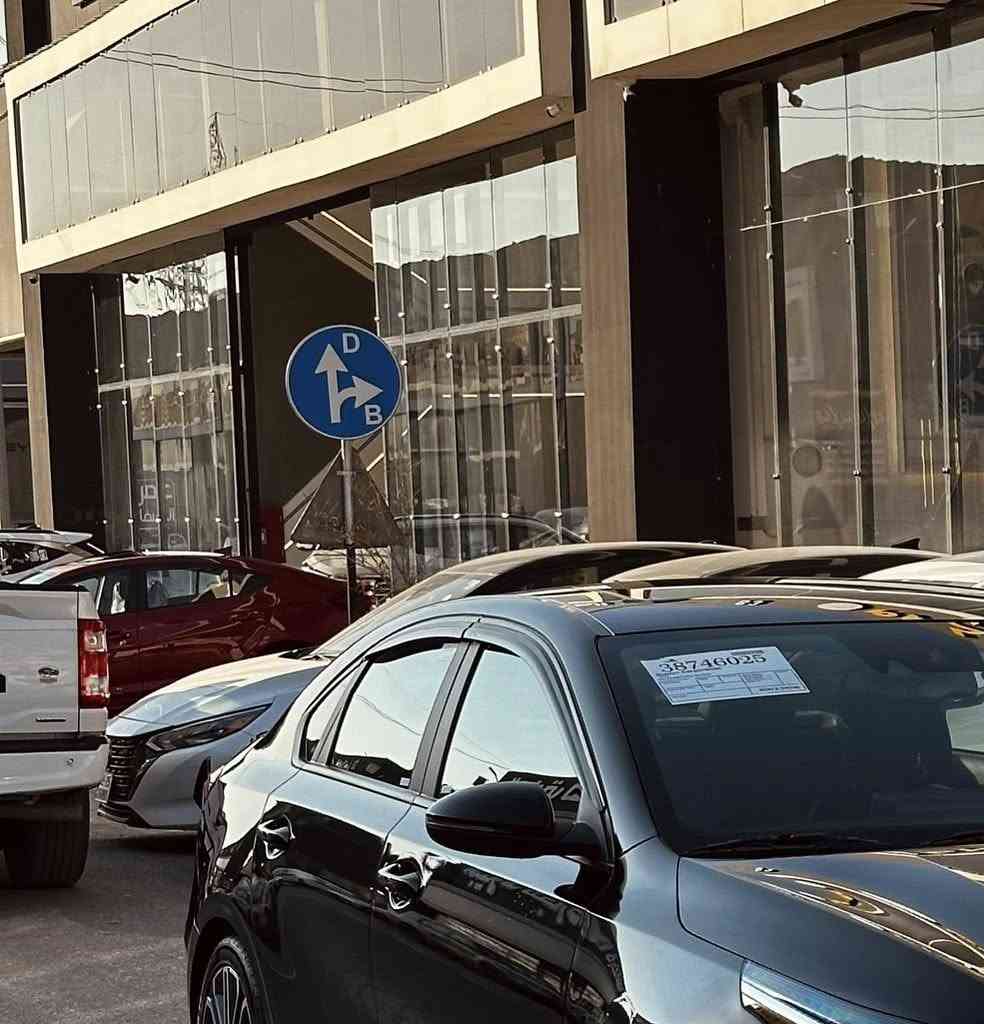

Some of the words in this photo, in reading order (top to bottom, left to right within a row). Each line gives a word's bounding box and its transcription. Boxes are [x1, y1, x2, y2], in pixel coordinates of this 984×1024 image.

[342, 333, 360, 353] D
[364, 404, 382, 425] B
[658, 653, 767, 674] 38746025
